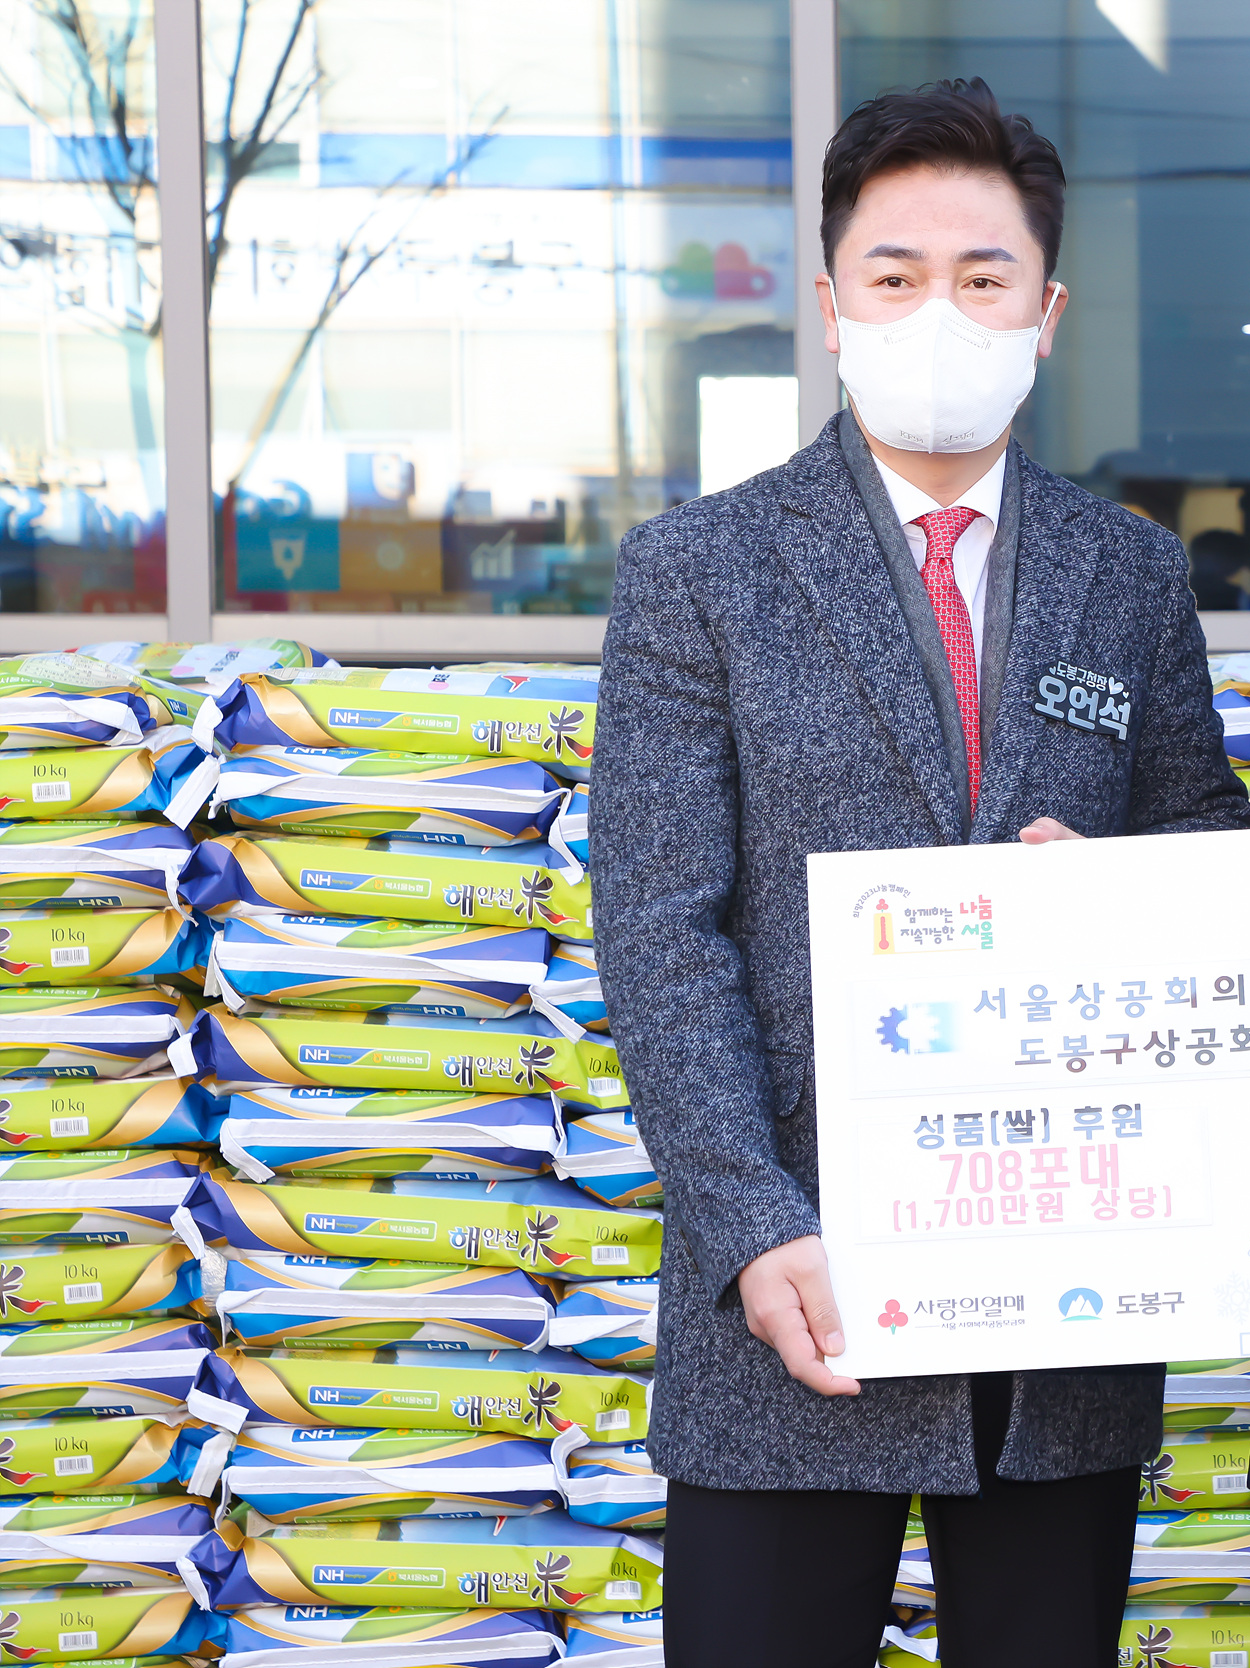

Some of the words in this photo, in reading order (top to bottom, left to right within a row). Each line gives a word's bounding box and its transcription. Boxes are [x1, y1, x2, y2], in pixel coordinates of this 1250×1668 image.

[1056, 660, 1108, 692] 도봉구청장
[1034, 675, 1131, 741] 오언석
[335, 711, 360, 725] NH
[33, 764, 48, 778] 10
[50, 763, 68, 779] kg
[306, 874, 331, 886] NH
[904, 906, 953, 924] 함께하는
[959, 894, 993, 921] 나눔
[51, 928, 65, 942] 10
[68, 928, 86, 944] kg
[900, 925, 955, 945] 지속가능한
[960, 921, 994, 950] 서울
[305, 1049, 330, 1061] NH
[588, 1057, 602, 1073] 10
[604, 1059, 621, 1077] kg
[51, 1098, 65, 1112] 10
[68, 1098, 85, 1114] kg
[1073, 1103, 1143, 1140] 후원
[938, 1143, 1120, 1195] 708포대
[310, 1218, 336, 1230] NH
[595, 1225, 610, 1240] 10
[612, 1227, 629, 1244] kg
[63, 1264, 79, 1278] 10
[81, 1264, 98, 1280] kg
[914, 1294, 1025, 1321] 사랑의열매
[1116, 1291, 1185, 1315] 도봉구
[315, 1390, 340, 1402] NH
[599, 1391, 614, 1407] 10
[616, 1391, 630, 1407] kg
[299, 1429, 336, 1440] NH
[54, 1437, 68, 1450] 10
[71, 1436, 89, 1453] kg
[1212, 1453, 1227, 1468] 10
[1229, 1453, 1247, 1471] kg
[318, 1568, 344, 1582] NH
[59, 1612, 74, 1626] 10
[77, 1612, 94, 1629] kg
[293, 1606, 329, 1618] NH
[1210, 1630, 1226, 1645] 10
[1227, 1631, 1245, 1648] kg
